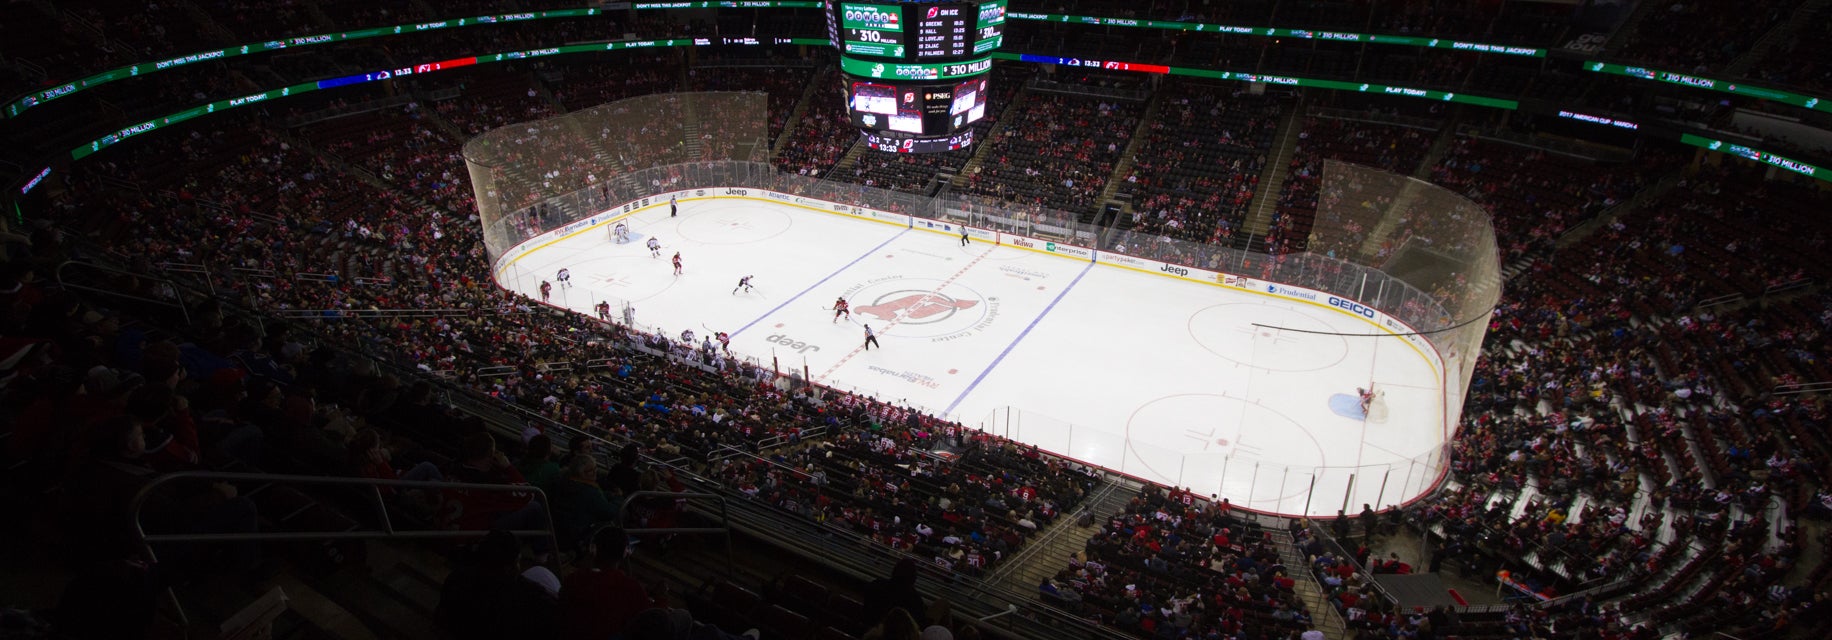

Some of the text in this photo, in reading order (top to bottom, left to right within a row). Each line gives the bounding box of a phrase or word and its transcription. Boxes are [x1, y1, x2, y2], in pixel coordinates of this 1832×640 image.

[860, 30, 880, 42] 310
[1505, 47, 1536, 55] JACKPOT
[156, 61, 172, 69] DON'T
[198, 51, 224, 60] JACKPOT
[951, 66, 966, 74] 310
[969, 58, 991, 72] MILLION
[1681, 76, 1714, 88] MILLION
[55, 84, 75, 96] MILLION
[1403, 88, 1426, 96] TODAY!
[230, 98, 244, 106] PLAY
[130, 122, 154, 134] MILLION
[1768, 155, 1814, 174] 310 MILLION
[726, 188, 747, 196] Jeep
[1014, 239, 1033, 248] Wawa
[1161, 264, 1188, 276] Jeep
[1280, 287, 1316, 301] Prudential
[1329, 296, 1374, 318] GEICO
[766, 334, 820, 353] Jeep
[1182, 497, 1190, 505] 13
